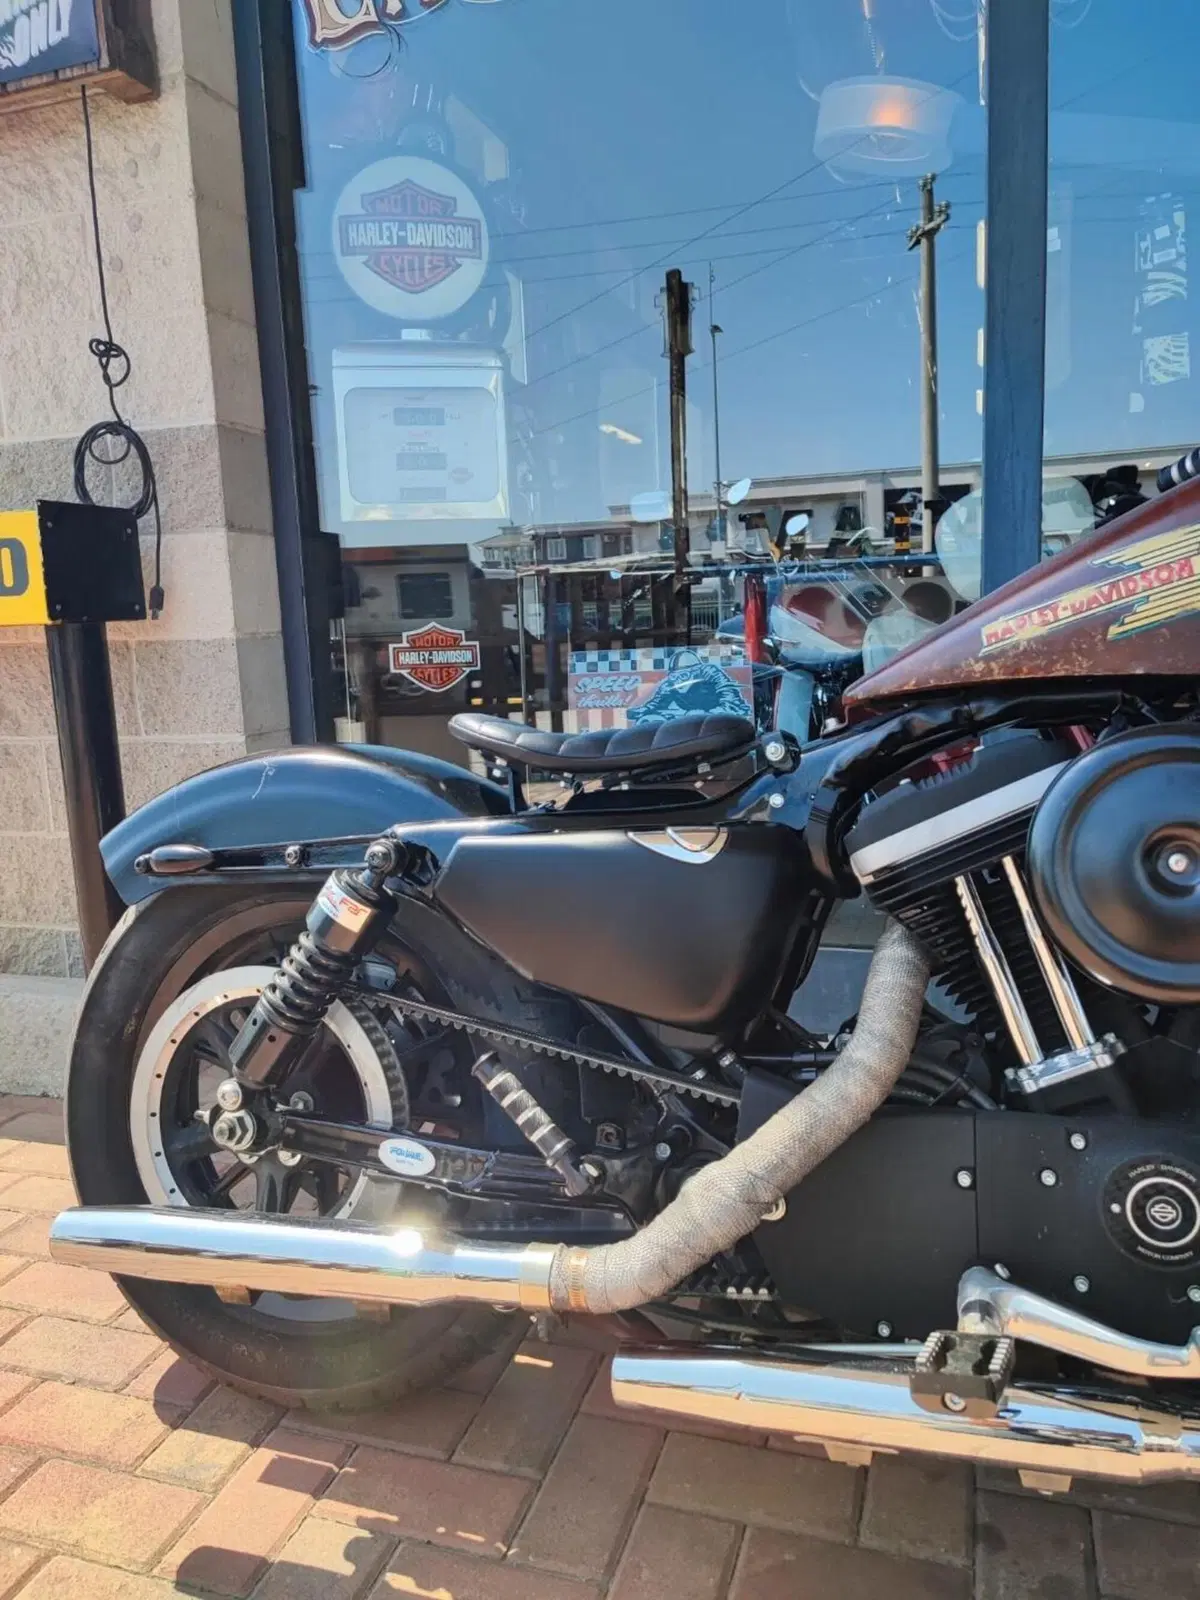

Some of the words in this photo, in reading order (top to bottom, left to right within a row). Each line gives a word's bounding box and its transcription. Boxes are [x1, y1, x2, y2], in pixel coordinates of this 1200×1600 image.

[375, 192, 442, 214] MOTOR
[348, 220, 474, 250] HARLEY-DAVIDSON
[380, 254, 446, 286] CYCLES
[415, 635, 456, 648] MOTOR
[398, 649, 473, 665] HARLEY-DAVIDSON
[573, 674, 642, 694] SPEED
